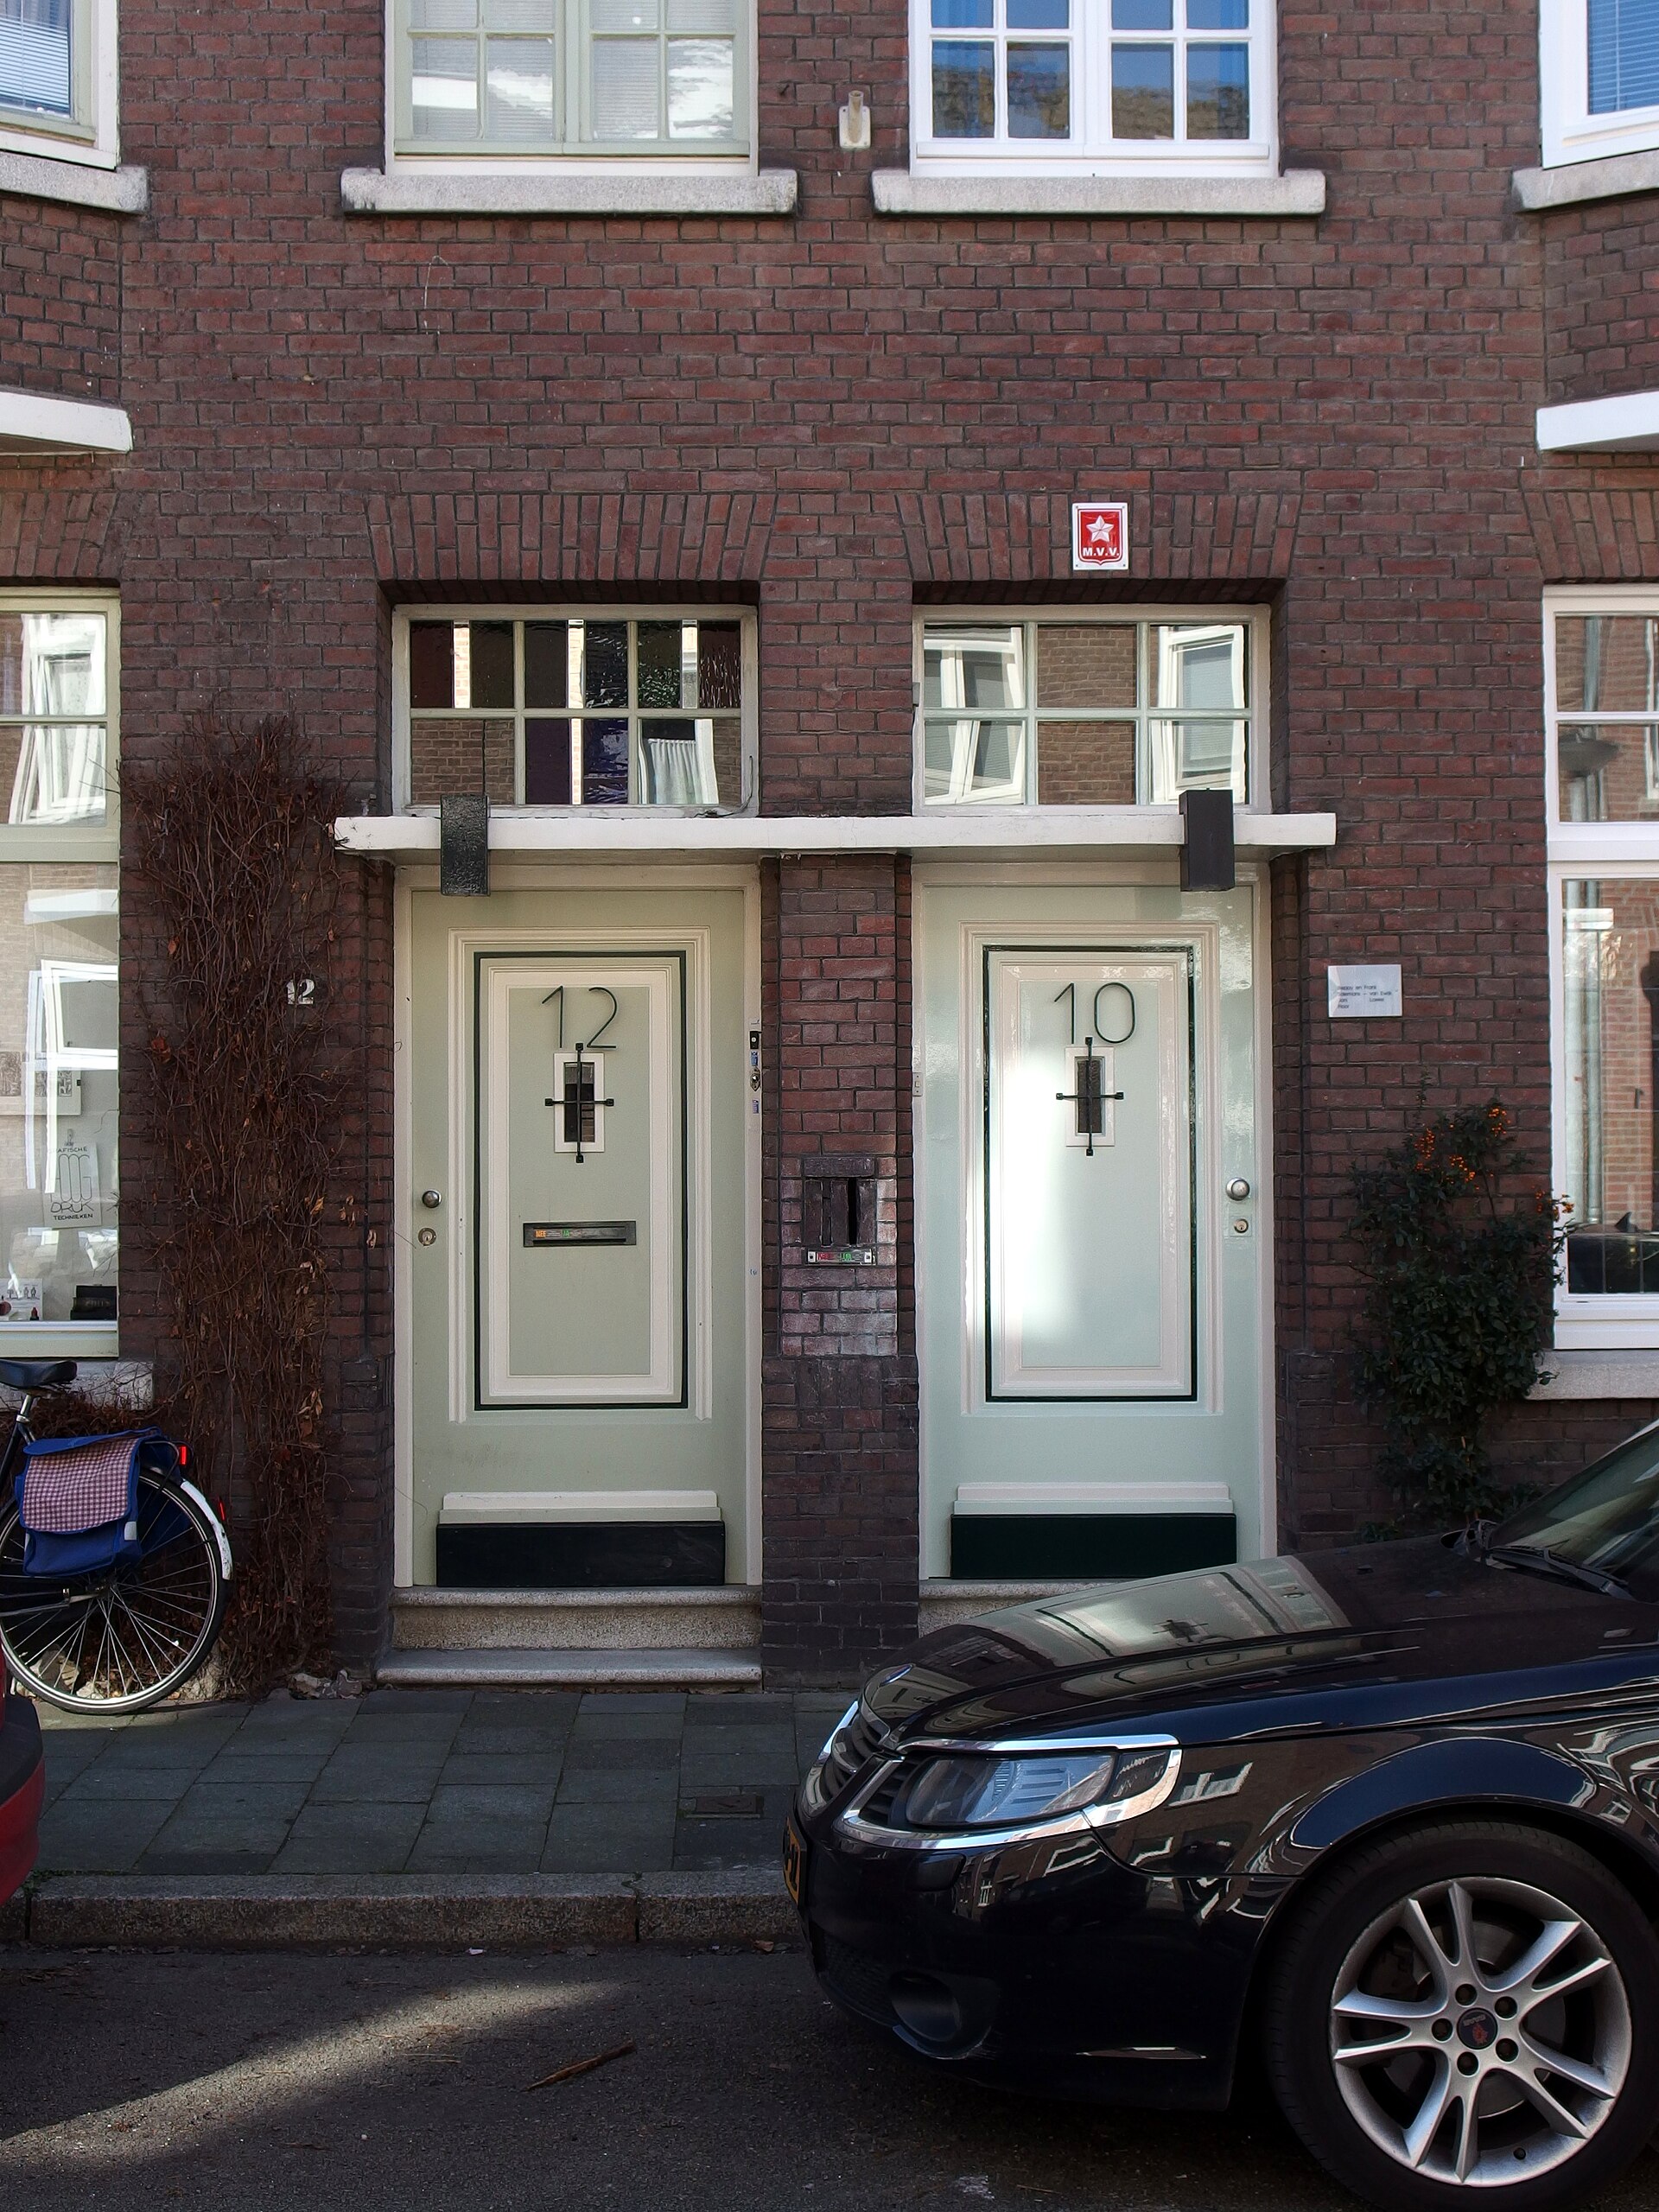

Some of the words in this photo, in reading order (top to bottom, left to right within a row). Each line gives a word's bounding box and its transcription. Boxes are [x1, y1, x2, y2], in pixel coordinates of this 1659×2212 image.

[1083, 547, 1120, 556] M.V.V.
[286, 978, 315, 1005] 12
[1054, 982, 1135, 1044] 10
[542, 985, 617, 1048] 12
